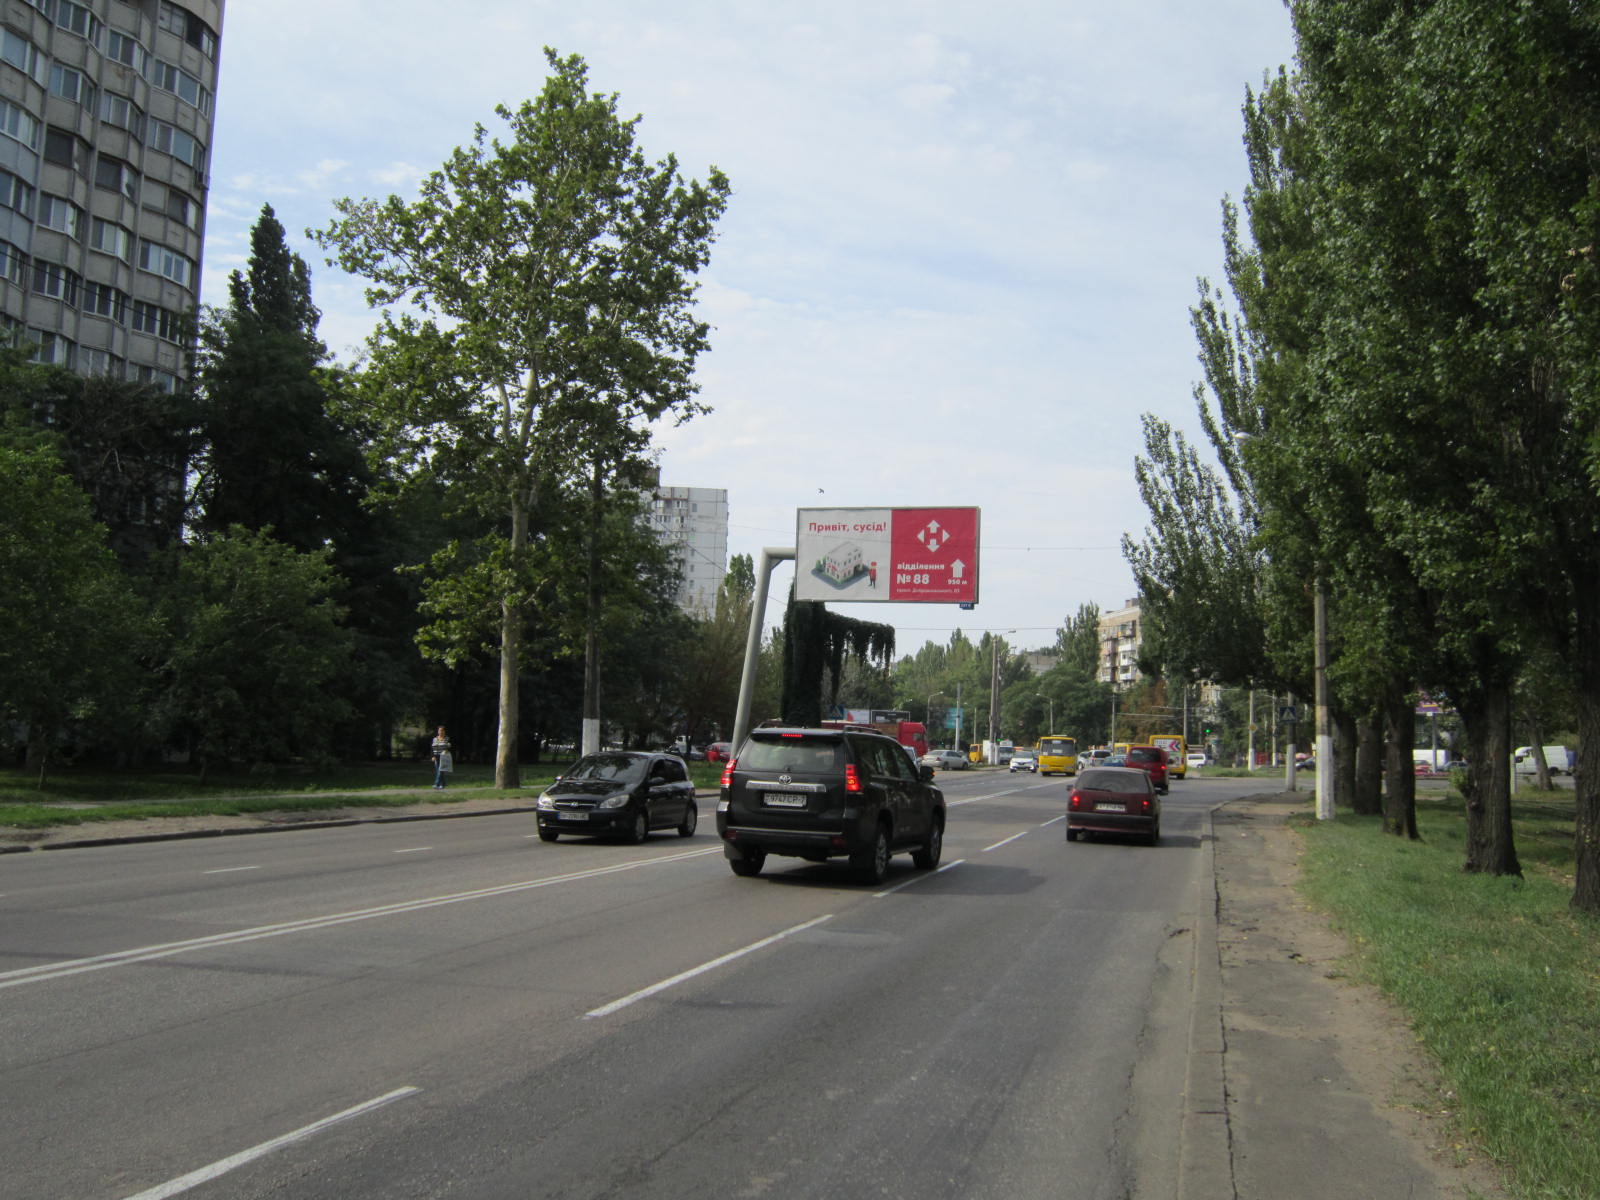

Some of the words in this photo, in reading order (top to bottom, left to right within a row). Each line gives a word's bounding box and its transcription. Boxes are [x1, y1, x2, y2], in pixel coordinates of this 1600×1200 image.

[809, 522, 850, 533] Привіт,
[853, 521, 886, 533] сусід!
[897, 562, 945, 570] відділення
[913, 573, 930, 585] 88
